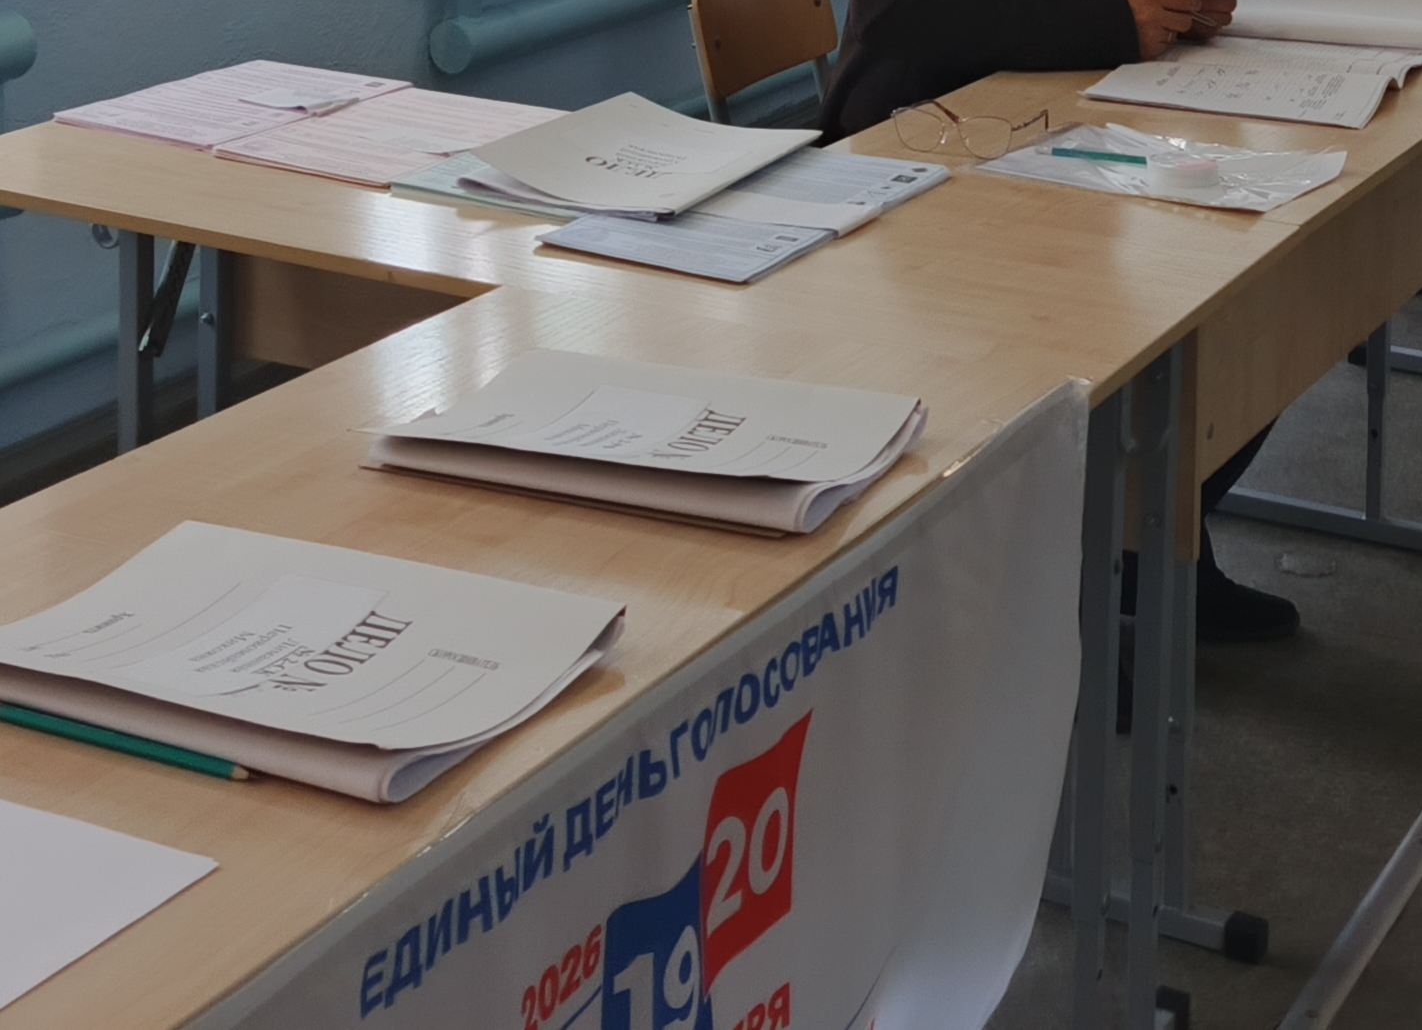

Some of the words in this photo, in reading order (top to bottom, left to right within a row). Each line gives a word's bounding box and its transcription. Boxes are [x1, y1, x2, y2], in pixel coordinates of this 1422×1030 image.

[667, 408, 747, 452] ДЕЛО
[303, 610, 413, 676] ДЕЛО
[360, 812, 556, 1021] ЕДИНЫЙ
[562, 748, 668, 874] ДЕНЬ
[669, 564, 899, 781] ГОЛОСОВАНИЯ
[706, 786, 789, 939] 20
[520, 924, 603, 1030] 2026
